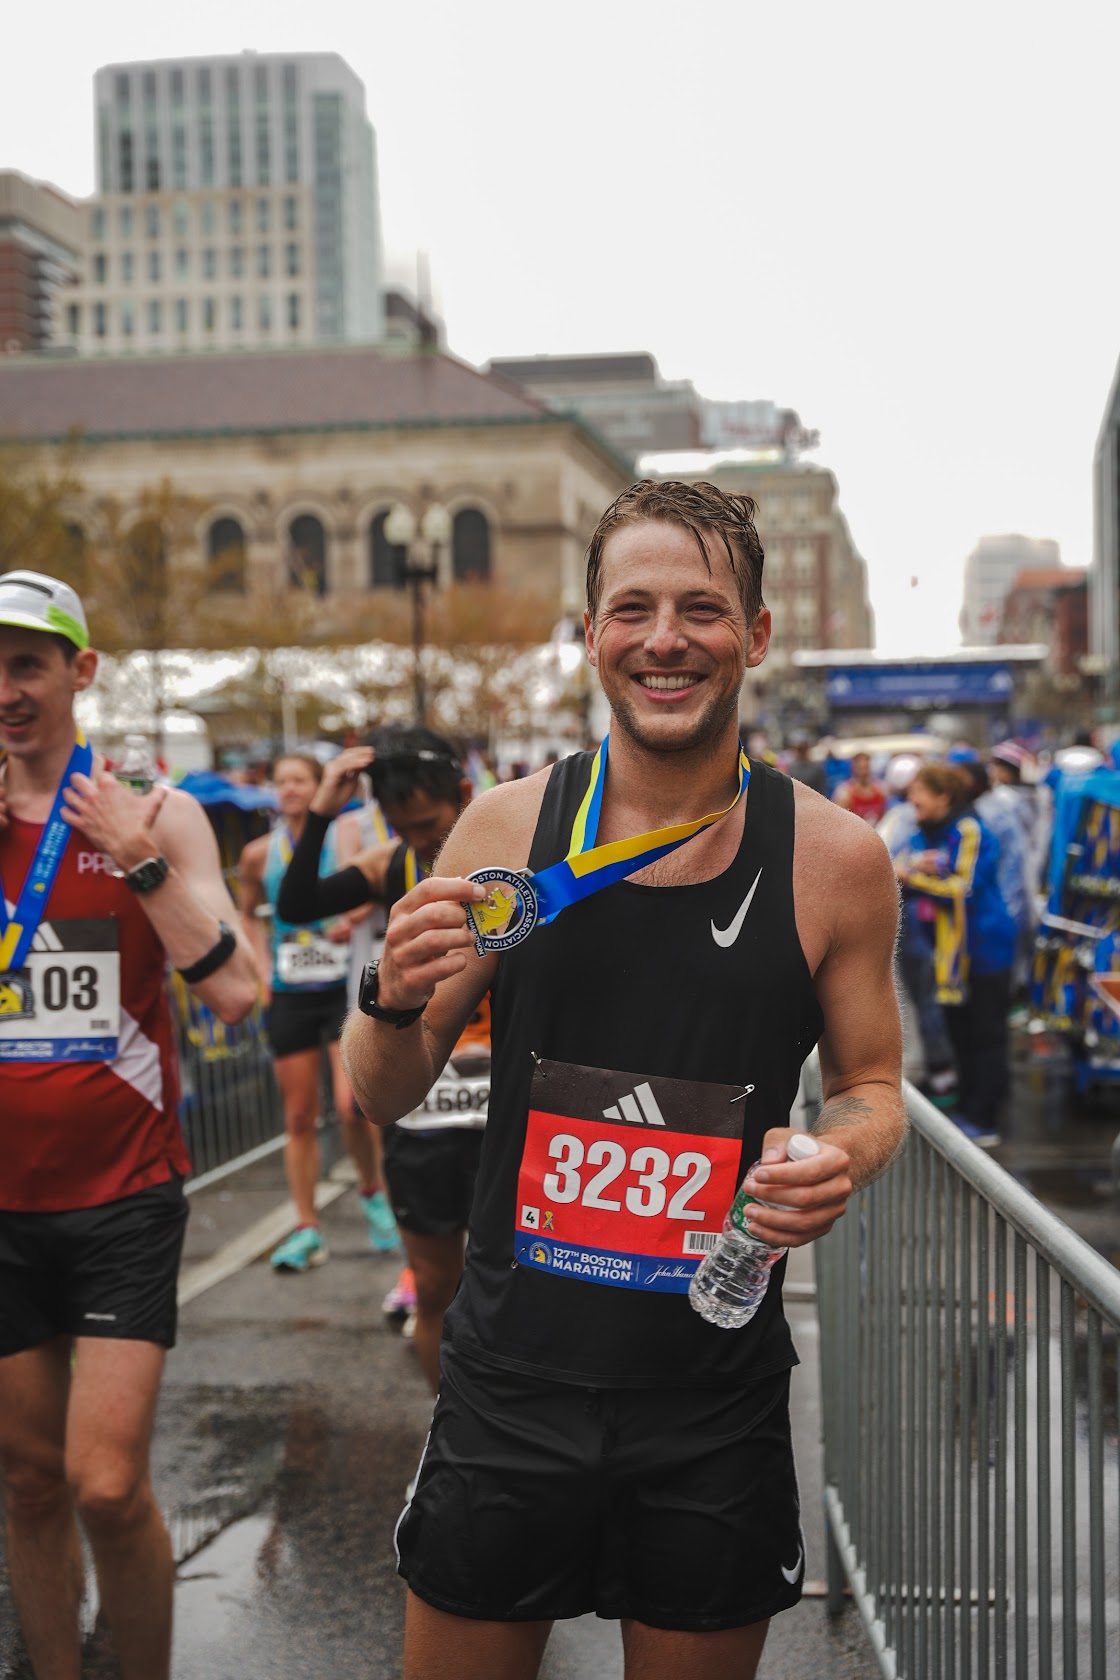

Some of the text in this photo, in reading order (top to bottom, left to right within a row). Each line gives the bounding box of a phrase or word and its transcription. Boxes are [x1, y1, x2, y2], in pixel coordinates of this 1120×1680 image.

[471, 872, 534, 948] OSTON ATHLETIC ASSOCIATION
[43, 966, 98, 1011] 03
[543, 1134, 712, 1221] 3232
[526, 1211, 535, 1224] 4
[553, 1258, 631, 1281] MARATHON
[580, 1253, 632, 1271] BOSTON
